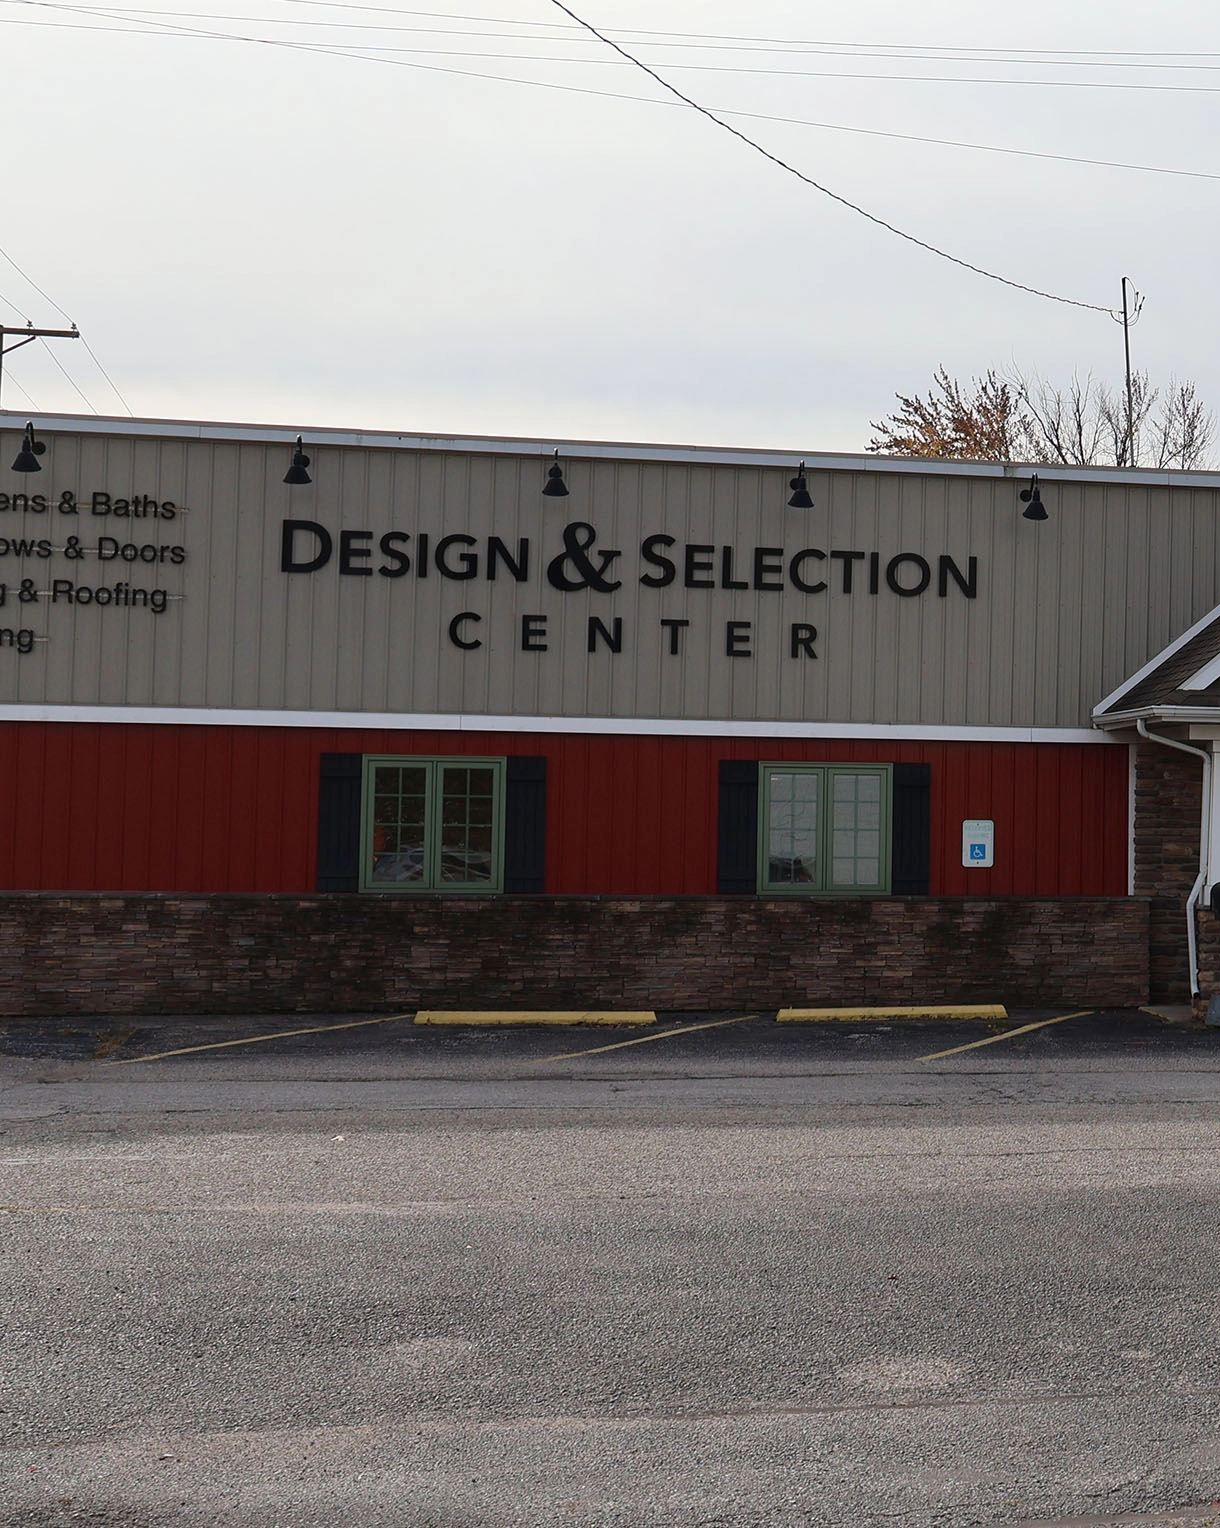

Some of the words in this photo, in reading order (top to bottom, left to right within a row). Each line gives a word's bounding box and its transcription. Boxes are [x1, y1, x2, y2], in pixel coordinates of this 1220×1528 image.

[58, 491, 79, 514] &
[91, 491, 177, 520] Baths
[64, 535, 84, 560] &
[98, 536, 186, 565] Doors
[281, 519, 530, 583] DESIGN
[547, 521, 623, 594] &
[639, 533, 978, 600] SELECTION
[18, 578, 39, 603] &
[52, 579, 168, 614] Roofing
[449, 611, 819, 660] CENTER
